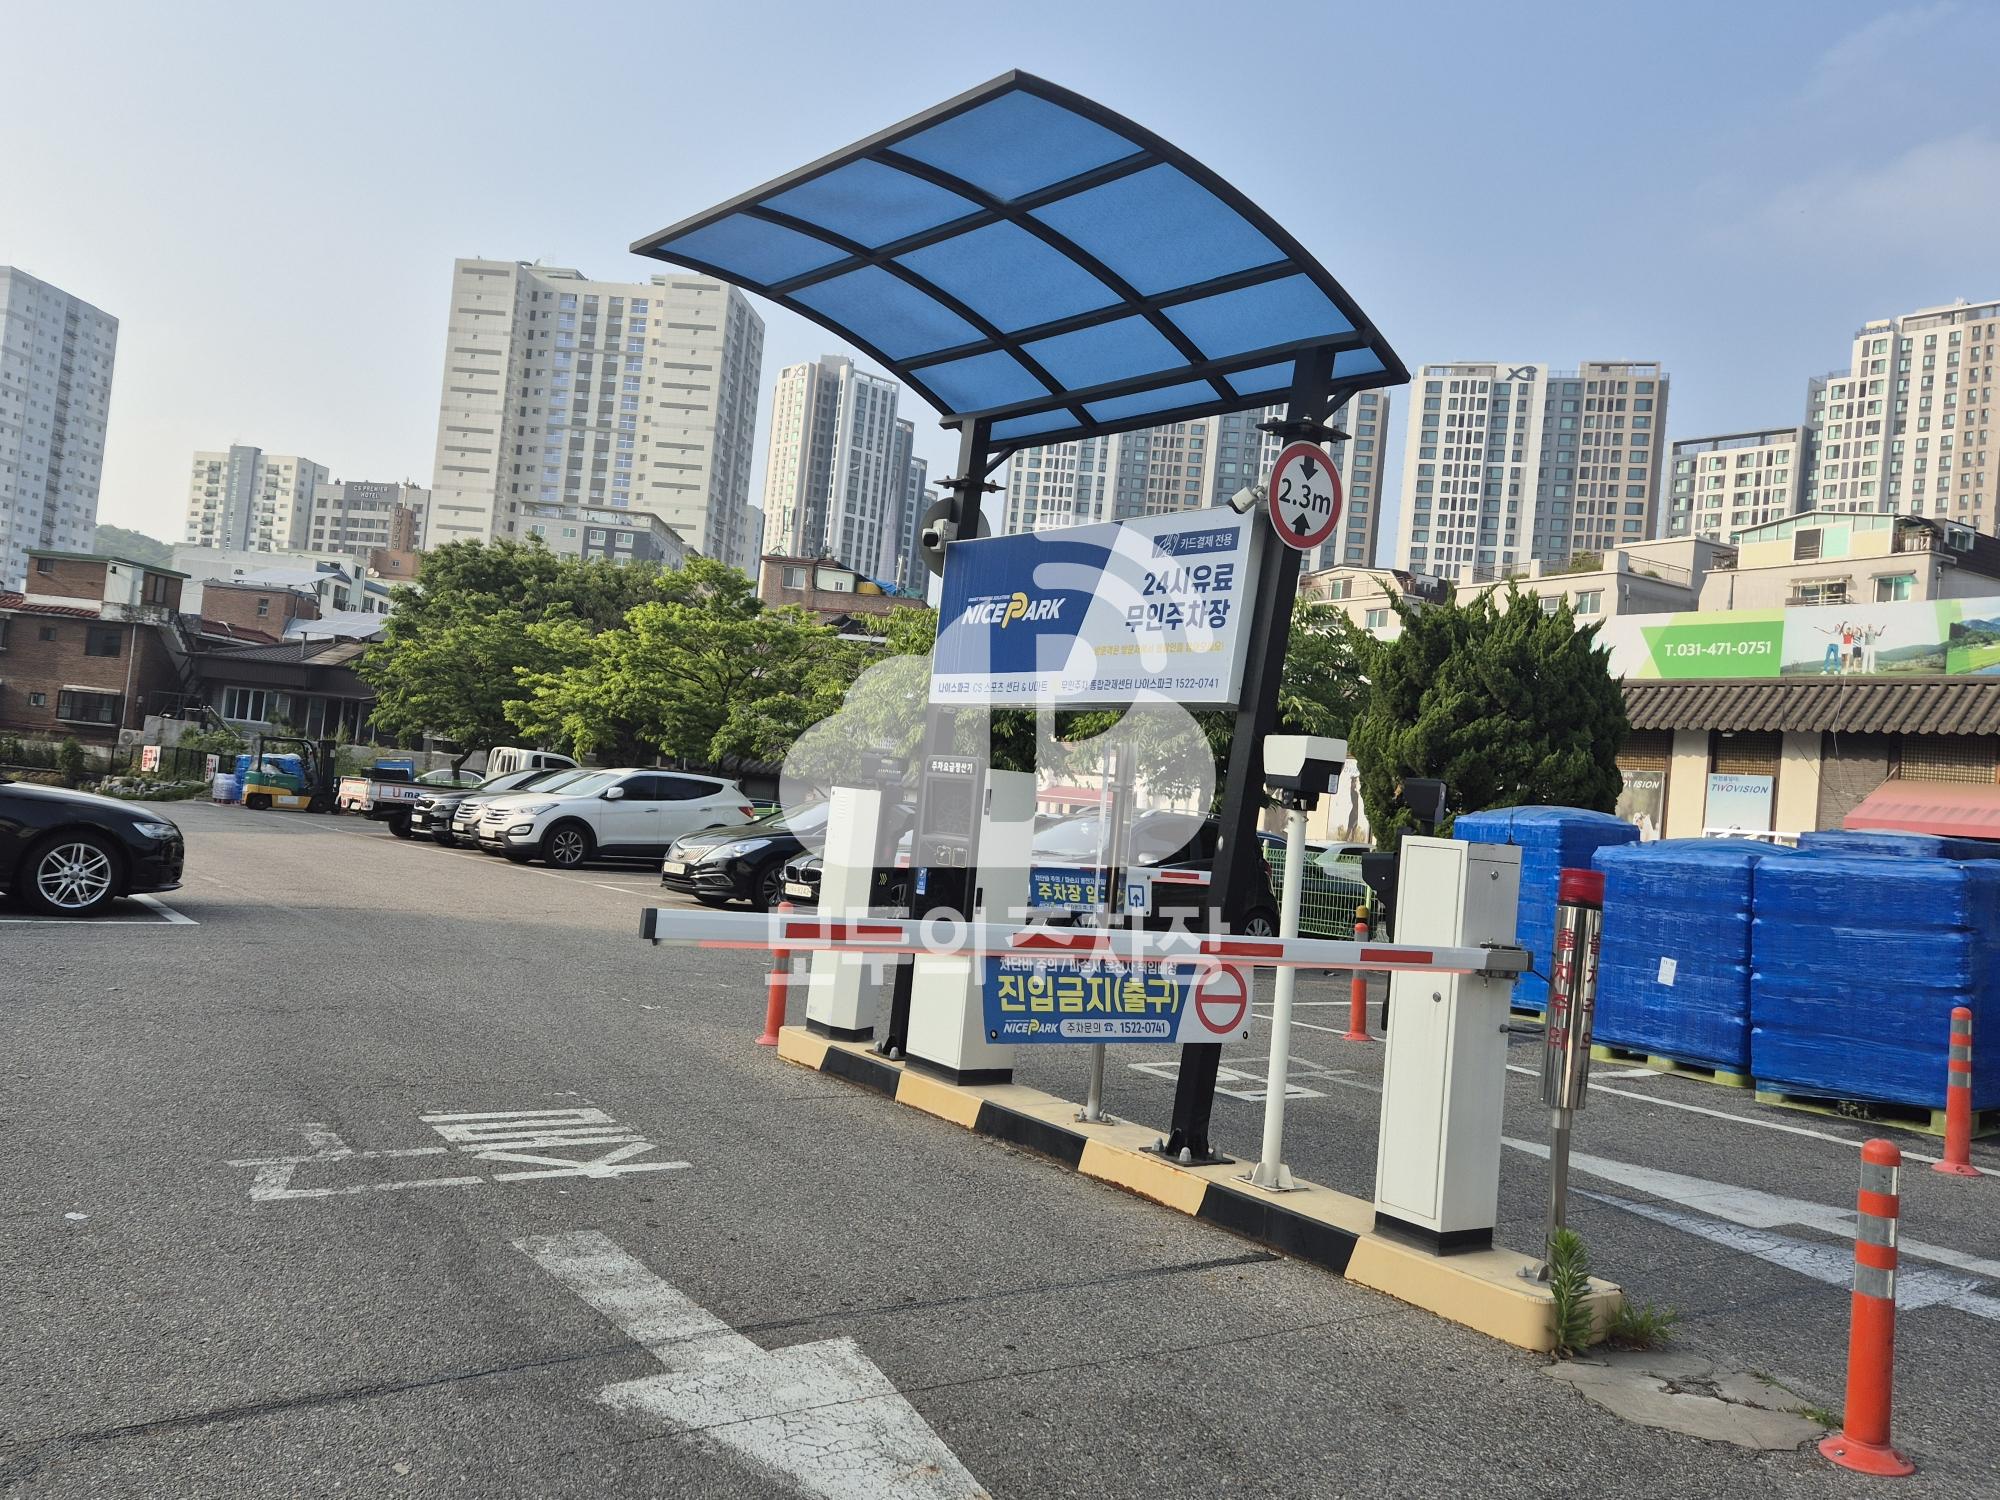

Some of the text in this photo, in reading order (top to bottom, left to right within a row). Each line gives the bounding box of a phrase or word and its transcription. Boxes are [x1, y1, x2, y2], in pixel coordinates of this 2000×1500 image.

[1279, 478, 1331, 515] 2.3m
[1180, 533, 1233, 550] 카드결제 전용
[1142, 563, 1234, 595] 24시유료
[962, 592, 1066, 628] NICEPARK
[1125, 599, 1231, 632] 무인주차장
[1664, 641, 1772, 657] T.031-471-0751
[1005, 681, 1019, 693] 센터
[1089, 679, 1133, 691] 통합관제센터
[1134, 678, 1172, 690] 나이스파크
[1175, 678, 1219, 689] 1522-0741
[931, 760, 973, 774] 주차요금정산기
[404, 791, 421, 799] ma
[1710, 783, 1769, 794] TWOVISION
[1038, 882, 1082, 902] 주차장
[1000, 957, 1033, 972] 차단바
[1036, 958, 1057, 973] 주의
[997, 975, 1179, 1013] 진입금지(출구)
[1003, 1018, 1166, 1035] NICEPARK 주차문의 1522-0741
